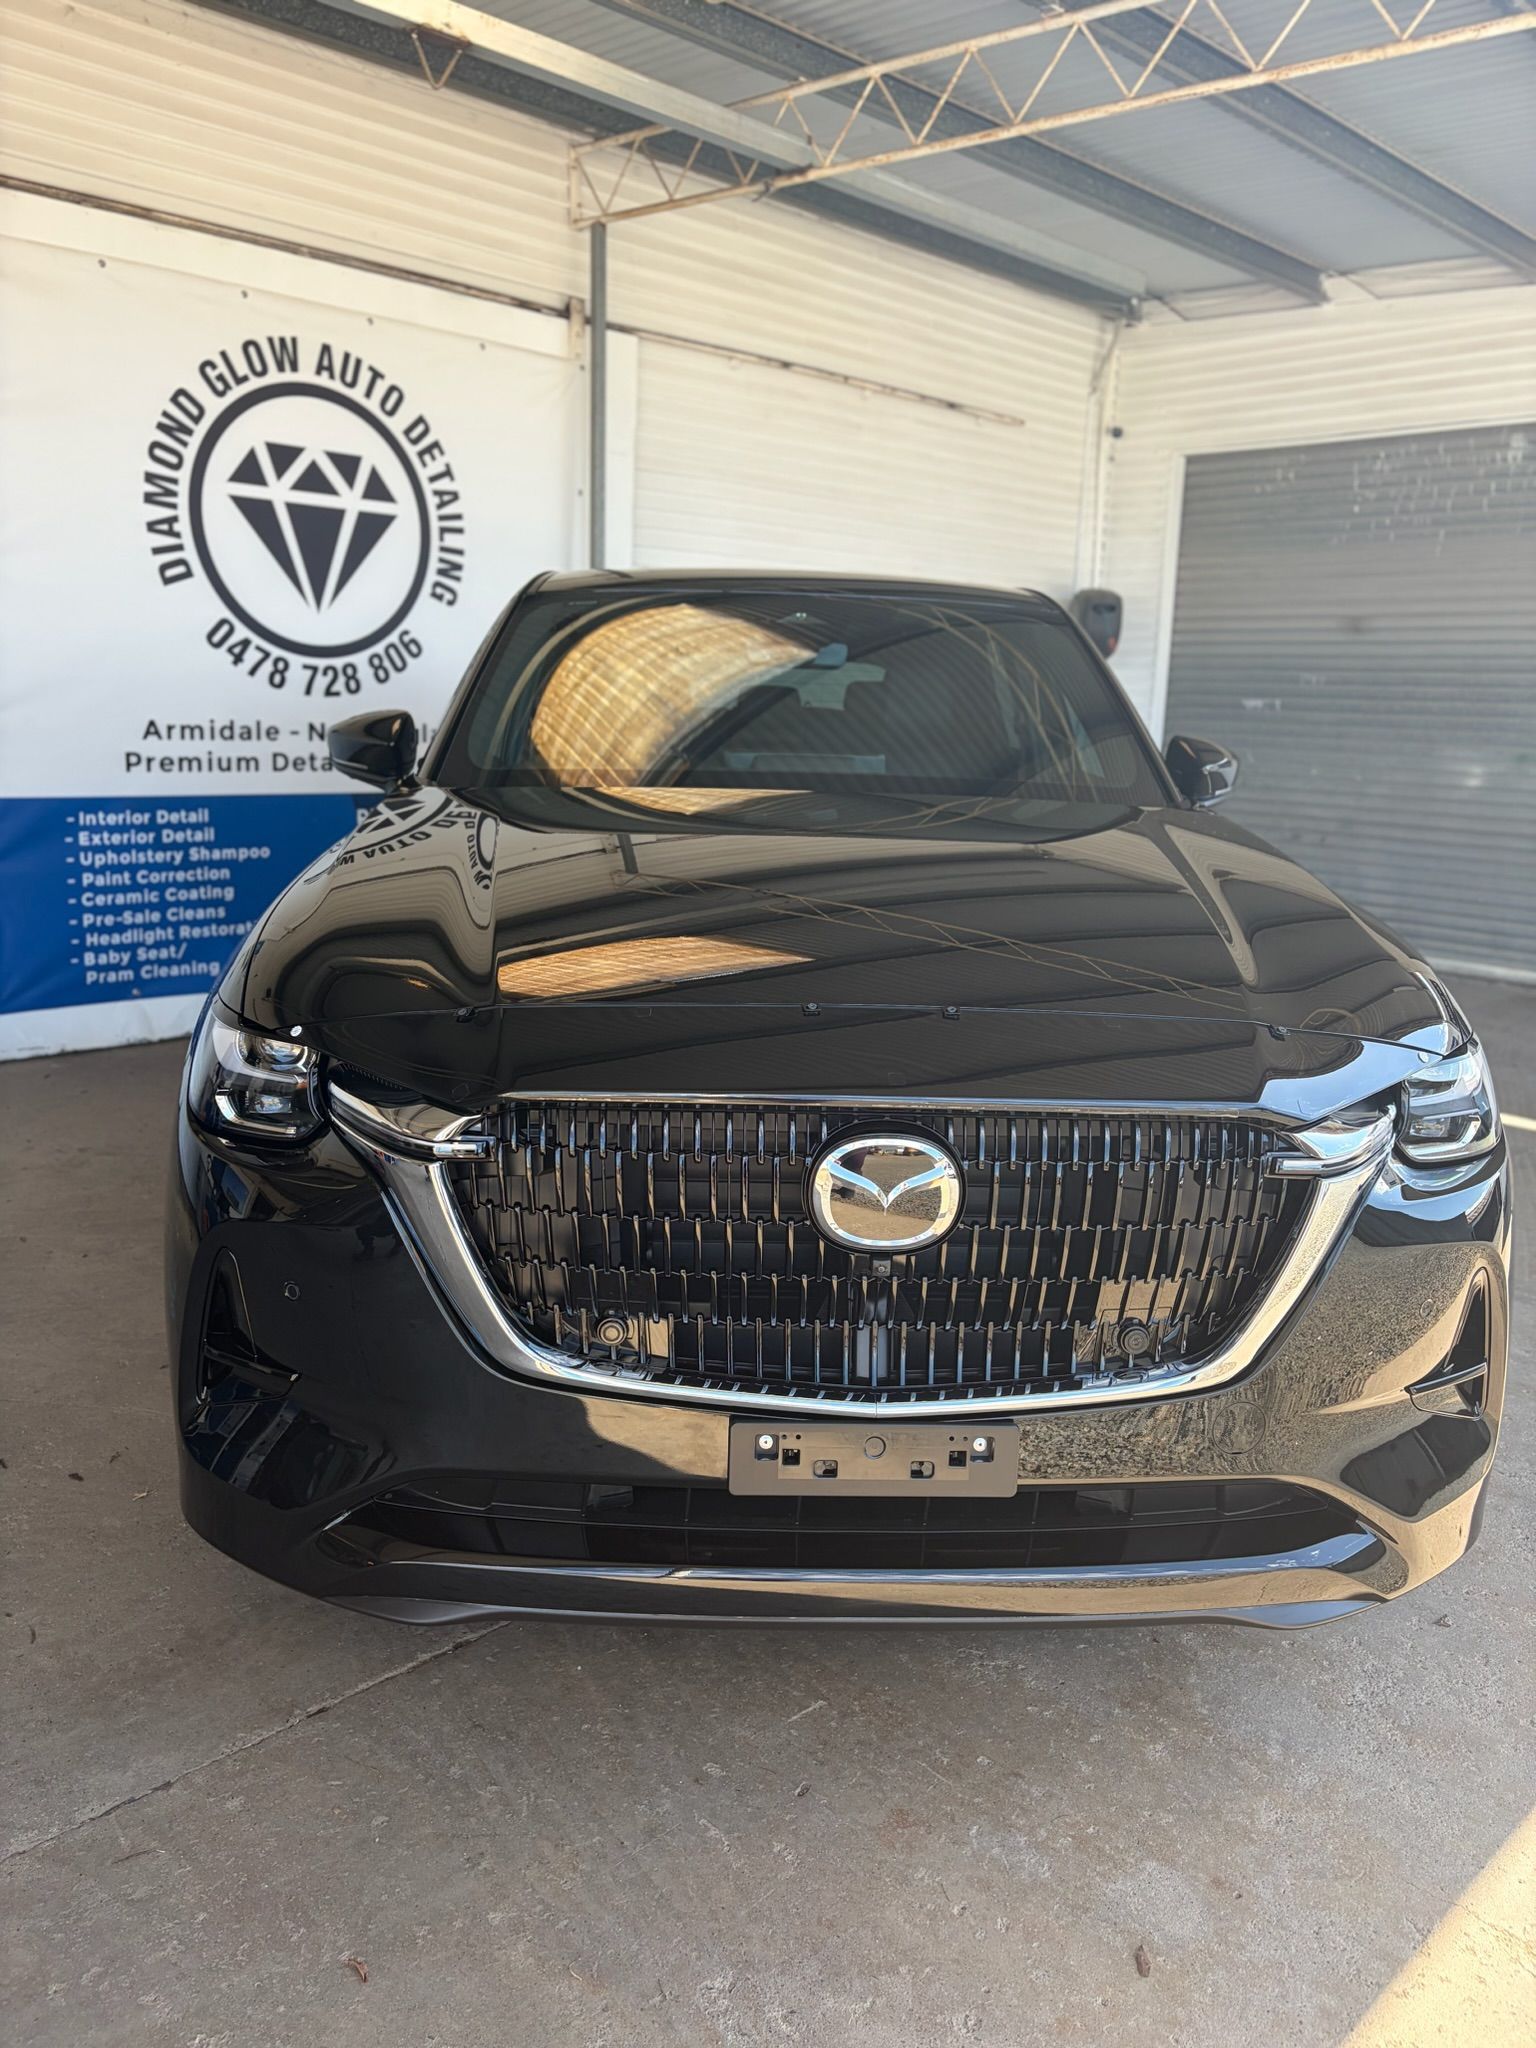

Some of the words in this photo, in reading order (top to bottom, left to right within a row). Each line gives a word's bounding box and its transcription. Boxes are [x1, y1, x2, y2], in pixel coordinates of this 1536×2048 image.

[143, 386, 207, 587] DIAMOND
[198, 336, 300, 398] GLOW
[314, 343, 405, 418] AUTO
[402, 414, 465, 607] DETAILING
[205, 617, 291, 690] 0478
[301, 663, 362, 698] 728
[368, 629, 424, 684] 806
[142, 719, 280, 742] Armidale
[125, 752, 260, 773] Premium
[272, 752, 334, 773] Deta
[78, 810, 151, 827] Interior
[156, 808, 210, 825] Detail
[78, 828, 156, 847] Exterior
[161, 826, 215, 843] Detail
[79, 849, 184, 868] Upholstery
[189, 846, 271, 862] Shampoo
[82, 870, 132, 887] Paint
[136, 866, 231, 884] Correction
[81, 889, 160, 908] Ceramic
[164, 885, 235, 902] Coating
[82, 910, 161, 928] Pre-Sale
[166, 905, 226, 922] Cleans
[85, 928, 174, 947] Headlight
[179, 921, 256, 939] Restorat
[84, 950, 132, 967] Baby
[86, 967, 134, 985] Pram
[140, 961, 220, 979] Cleaning
